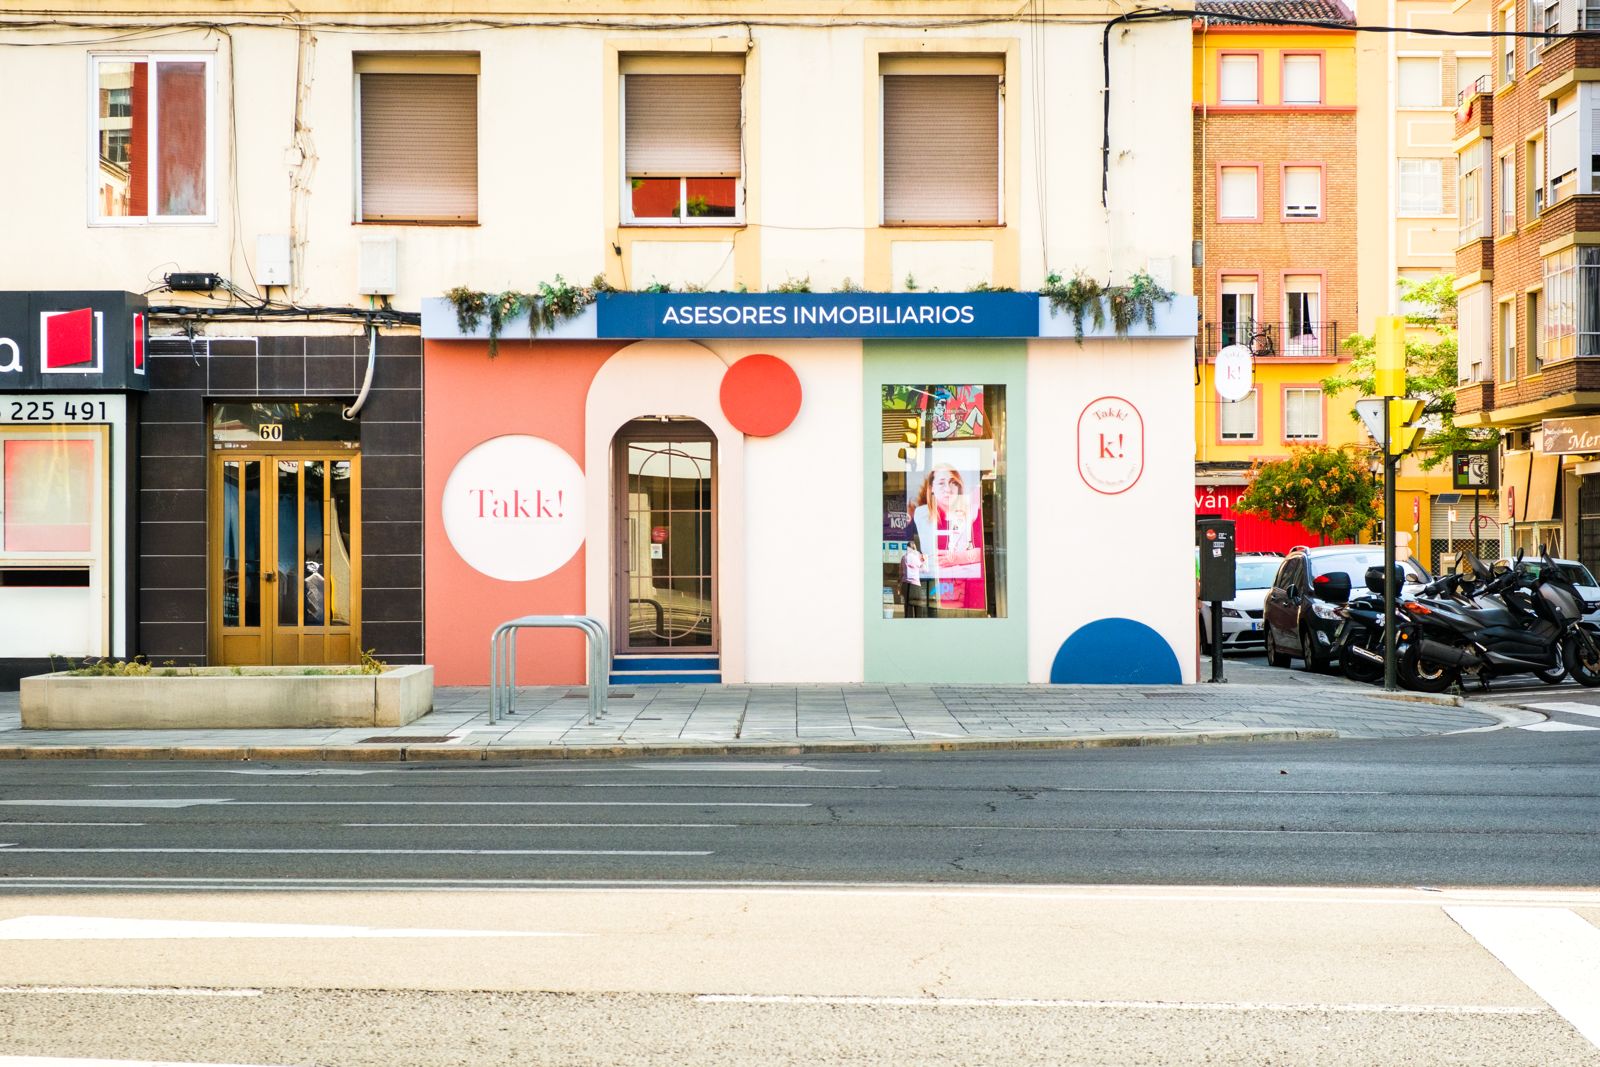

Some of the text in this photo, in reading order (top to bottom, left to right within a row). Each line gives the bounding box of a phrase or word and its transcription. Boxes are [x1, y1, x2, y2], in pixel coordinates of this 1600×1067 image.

[662, 305, 975, 324] ASESORES INMOBILIARIOS
[11, 401, 54, 420] 225
[64, 401, 106, 420] 491
[1092, 407, 1129, 421] Takk!
[260, 425, 282, 440] 60
[1099, 433, 1124, 459] k!
[468, 489, 564, 518] Takk!
